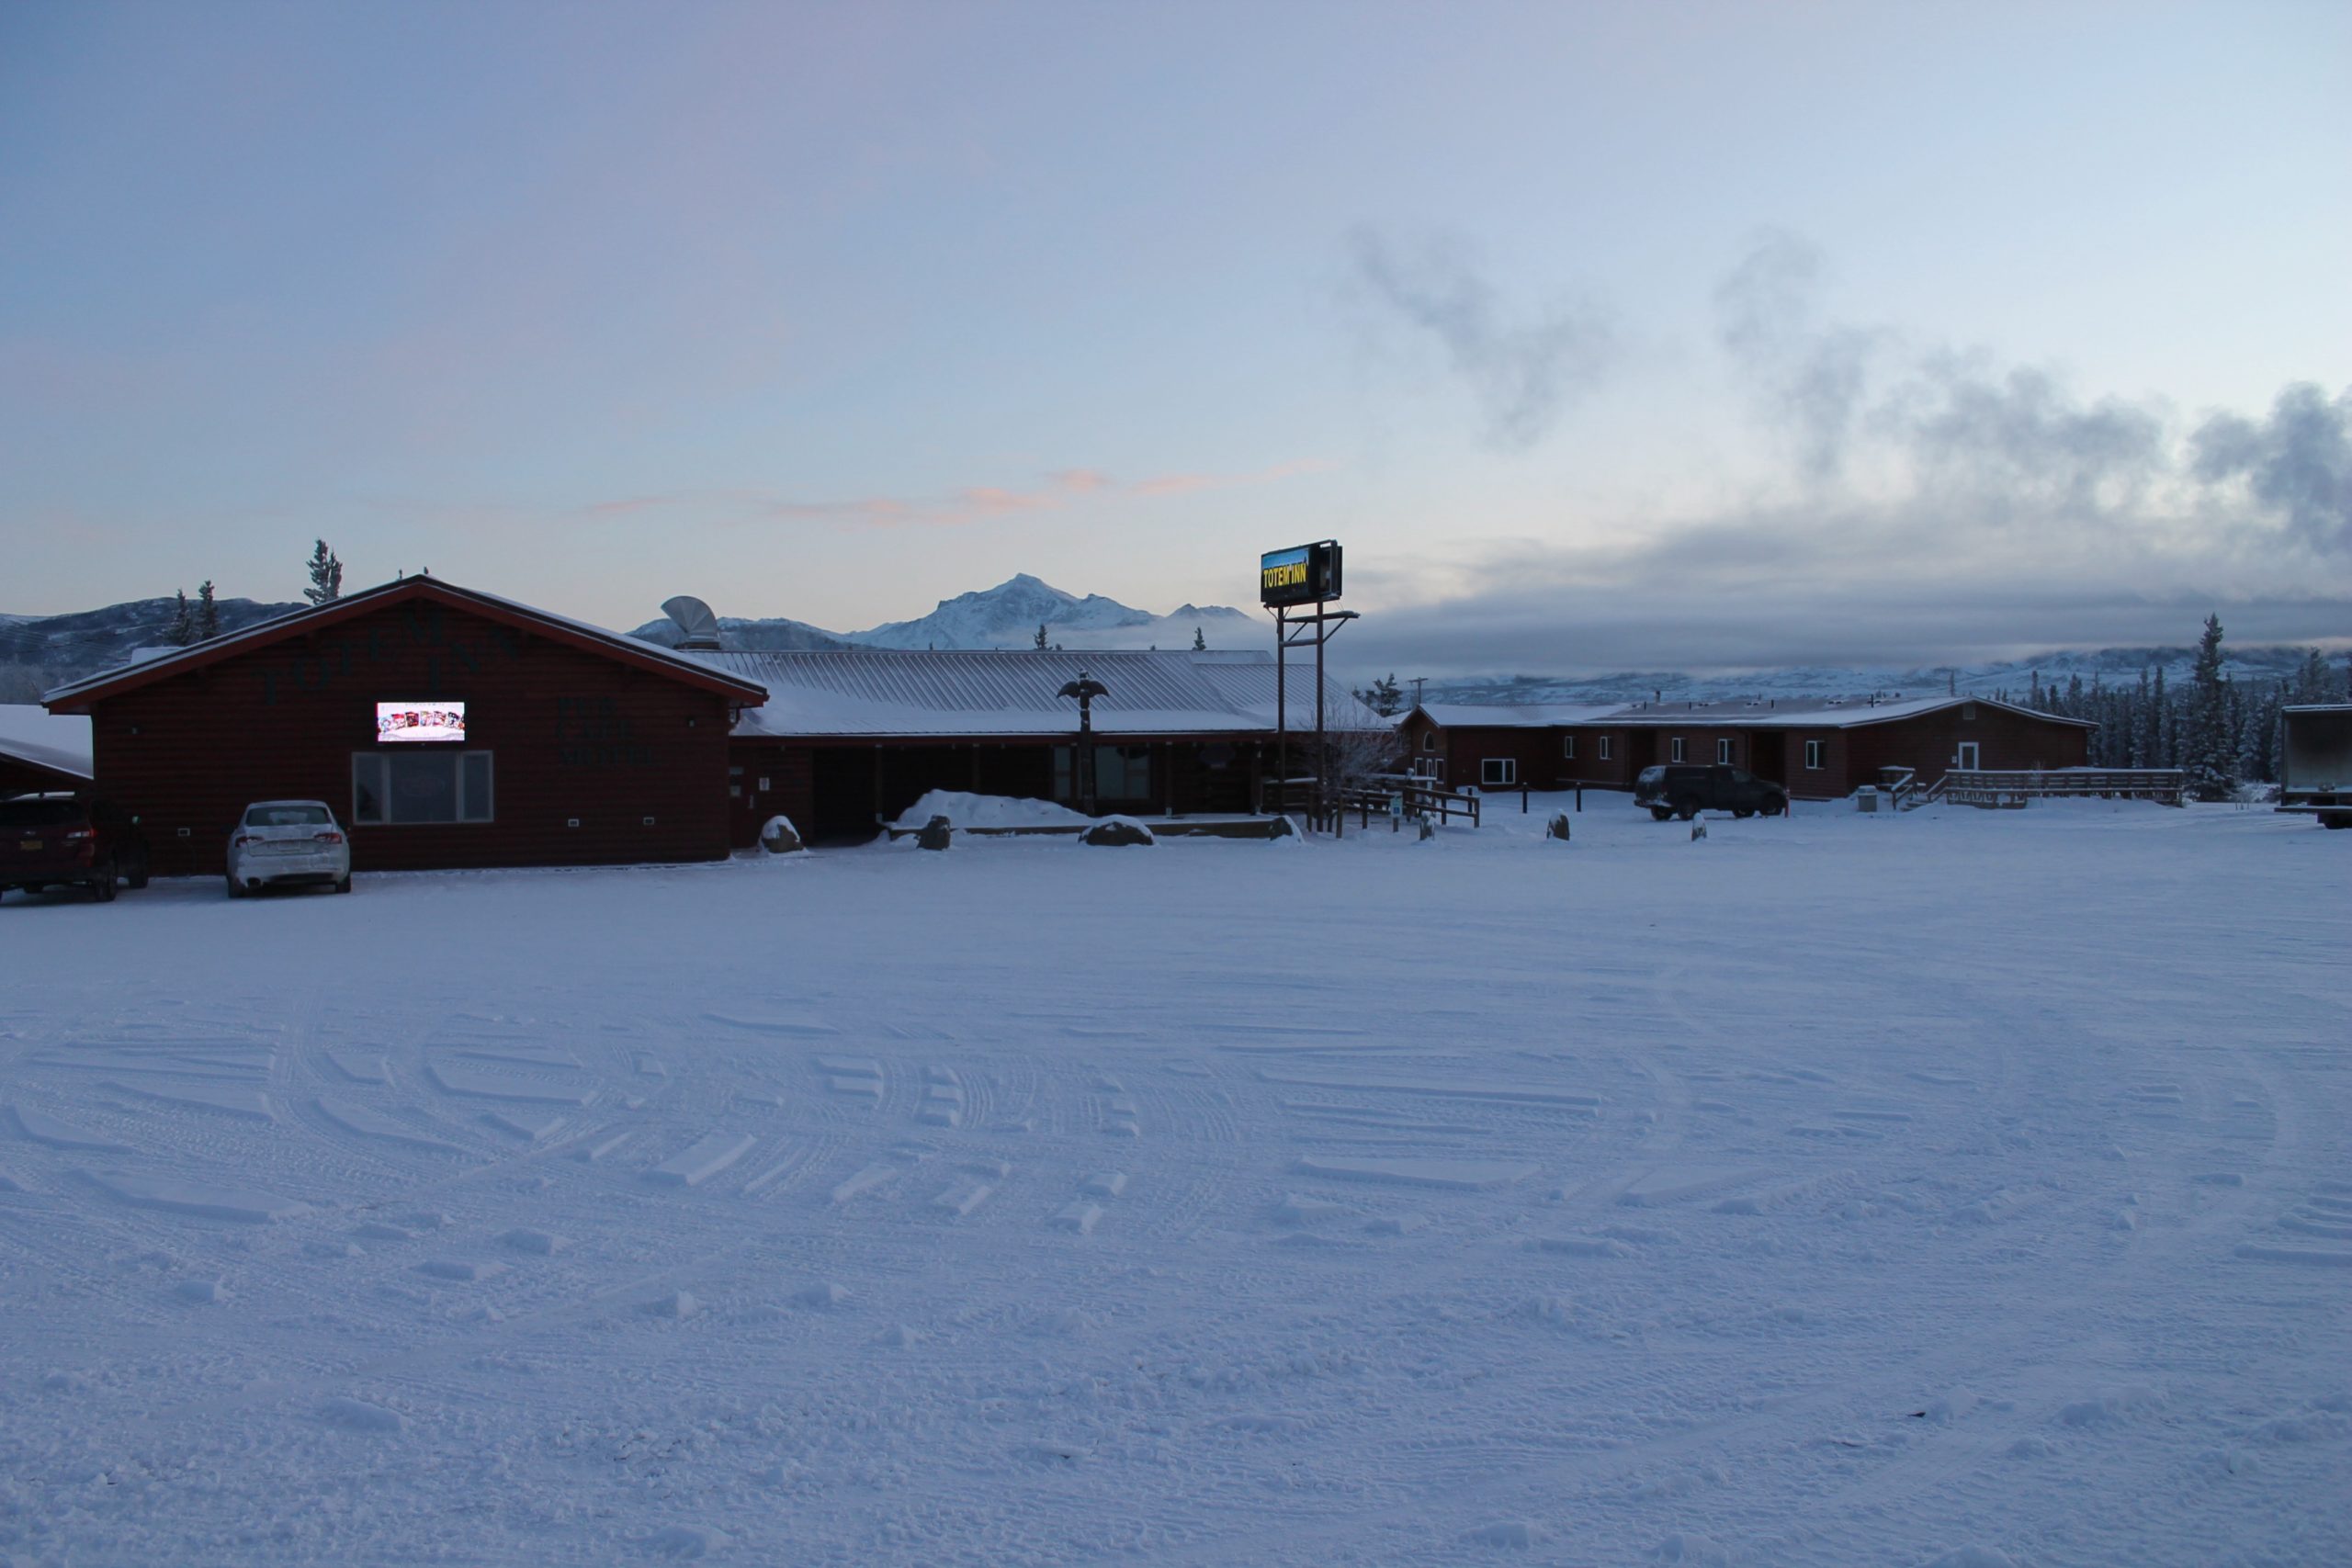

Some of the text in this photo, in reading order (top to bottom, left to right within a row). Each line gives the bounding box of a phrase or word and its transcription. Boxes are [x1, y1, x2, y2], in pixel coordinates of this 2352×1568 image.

[1263, 563, 1306, 589] TOTEM INN
[250, 606, 443, 706] TOTEM
[427, 626, 521, 692] INN
